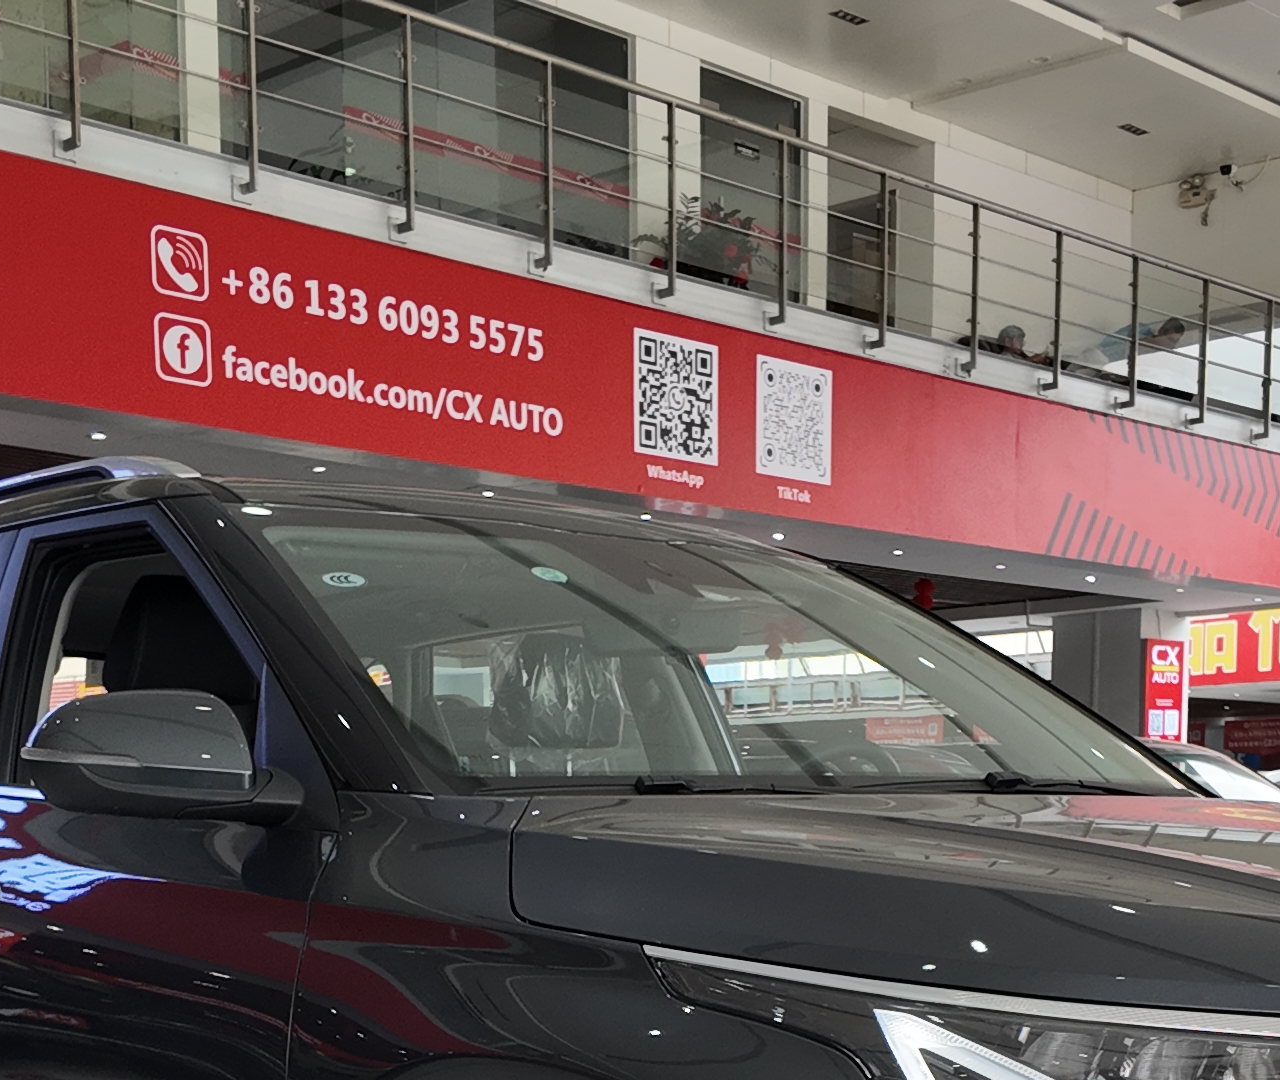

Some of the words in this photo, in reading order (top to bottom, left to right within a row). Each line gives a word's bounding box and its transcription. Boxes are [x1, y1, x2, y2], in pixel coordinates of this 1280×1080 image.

[222, 265, 294, 309] +86
[304, 279, 369, 326] 133
[377, 296, 460, 345] 6093
[468, 314, 545, 361] 5575
[222, 345, 483, 425] facebook.com/CX
[490, 396, 564, 437] AUTO
[646, 463, 705, 489] WhatsApp
[777, 485, 812, 505] TikTok
[1151, 645, 1180, 667] CX
[1151, 671, 1180, 685] AUTO
